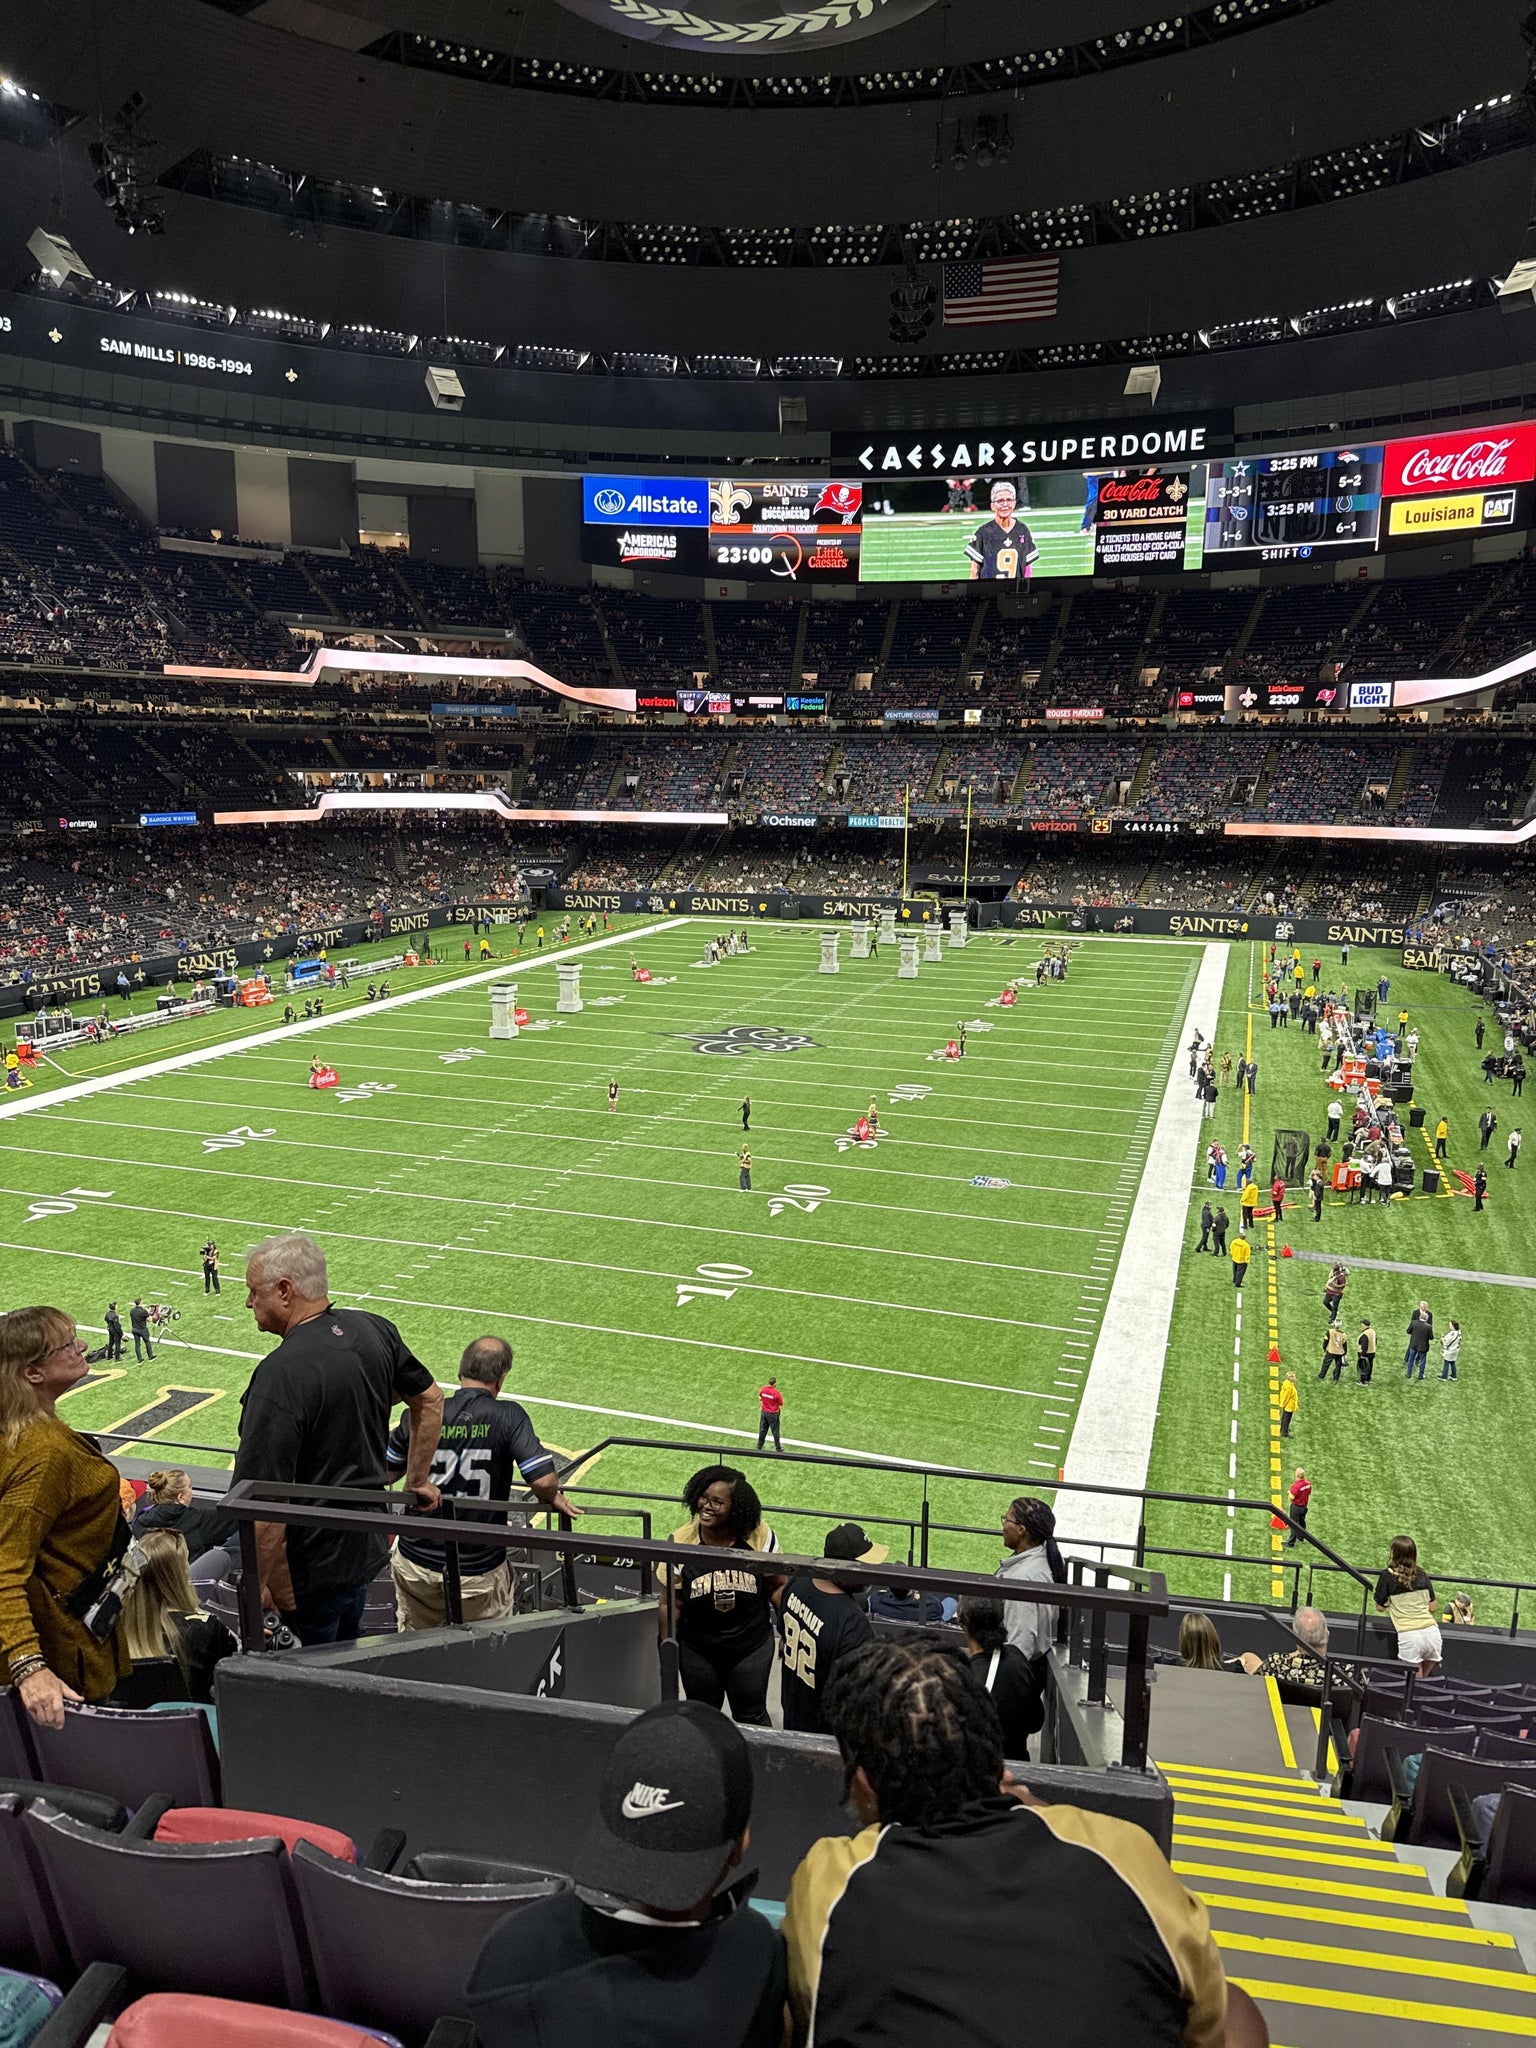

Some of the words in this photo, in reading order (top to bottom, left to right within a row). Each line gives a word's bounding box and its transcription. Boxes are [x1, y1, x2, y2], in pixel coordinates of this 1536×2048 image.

[101, 338, 131, 356] SAM
[134, 343, 174, 363] MILLS
[184, 353, 252, 375] 1986-1994
[858, 440, 1017, 471] CAESARS
[1022, 428, 1206, 463] SUPERDOME
[1270, 459, 1297, 472] 3:25
[1298, 456, 1318, 469] PM
[1401, 438, 1515, 486] Coca-Cola
[1338, 474, 1361, 488] 5-2
[763, 485, 808, 497] SAINTS
[1100, 478, 1164, 503] Coca-Cola
[1218, 485, 1252, 498] 3-3-1
[627, 495, 698, 514] Allstate
[1267, 503, 1294, 516] 3:25
[1296, 502, 1314, 513] PM
[1484, 498, 1512, 518] CAT
[1103, 510, 1118, 520] 30
[1120, 507, 1147, 519] YARD
[1149, 505, 1184, 517] CATCH
[1405, 506, 1474, 524] Louisiana
[752, 525, 787, 533] COUNTDOWN
[796, 525, 818, 533] KICKOFF
[1335, 521, 1357, 534] 6-1
[617, 530, 677, 549] AMERICAS
[1100, 535, 1106, 544] 2
[1106, 533, 1131, 543] TICKETS
[1131, 533, 1139, 542] TO
[1140, 533, 1146, 542] A
[1146, 532, 1163, 541] HOME
[1164, 531, 1182, 540] GAME
[1223, 529, 1242, 542] 1-6
[816, 547, 843, 559] Little
[1101, 543, 1142, 553] MULTI-PACKS
[1142, 543, 1150, 552] OF
[1151, 541, 1185, 551] COCA-COLA
[718, 547, 772, 563] 23:00
[1103, 553, 1119, 563] $200
[1120, 552, 1144, 562] ROUSES
[1144, 551, 1159, 561] GIFT
[1159, 550, 1177, 560] CARD
[808, 556, 848, 568] Caesars
[997, 549, 1018, 578] 9
[34, 656, 64, 665] SAINTS
[100, 660, 128, 670] SAINTS
[20, 688, 50, 697] SAINTS
[83, 691, 111, 700] SAINTS
[1358, 685, 1384, 695] BUD
[143, 693, 169, 702] SAINTS
[200, 697, 225, 705] SAINTS
[312, 700, 340, 708] SAINTS
[638, 697, 676, 707] verizon
[1194, 694, 1224, 702] TOYOTA
[1269, 694, 1300, 705] 23:00
[1353, 695, 1388, 705] LIGHT
[371, 702, 399, 710] SAINTS
[1132, 707, 1160, 715] SAINTS
[852, 709, 879, 717] SAINTS
[885, 711, 914, 719] VENTURE
[914, 711, 939, 719] GLOBAL
[1046, 709, 1071, 718] ROUSES
[1072, 709, 1104, 718] MARKETS
[731, 812, 758, 821] SAINTS
[769, 815, 817, 827] Ochsner
[850, 816, 878, 827] PEOPLES
[917, 816, 945, 825] SAINTS
[979, 818, 1007, 826] SAINTS
[12, 820, 43, 830] SAINTS
[68, 818, 97, 829] entergy
[1030, 820, 1077, 832] verizon
[1094, 820, 1109, 831] 25
[1124, 822, 1179, 832] CAESARS
[1189, 822, 1220, 830] SAINTS
[927, 873, 1001, 883] SAINTS
[564, 894, 621, 909] SAINTS
[691, 897, 749, 912] SAINTS
[455, 906, 517, 922] SAINTS
[823, 902, 881, 917] SAINTS
[389, 913, 429, 933] SAINTS
[1169, 916, 1238, 934] SAINTS
[1328, 925, 1403, 945] SAINTS
[178, 948, 237, 972] SAINTS
[201, 1126, 277, 1149] 20
[767, 1184, 831, 1213] 20
[676, 1262, 753, 1300] 10
[440, 1425, 468, 1439] AMPA
[471, 1424, 491, 1438] BAY
[427, 1449, 492, 1500] 25
[690, 1572, 713, 1599] NEW
[713, 1569, 758, 1595] ORLEANS
[786, 1592, 825, 1637] GODCHAUX
[783, 1611, 817, 1689] 92
[630, 1781, 670, 1808] NIKE
